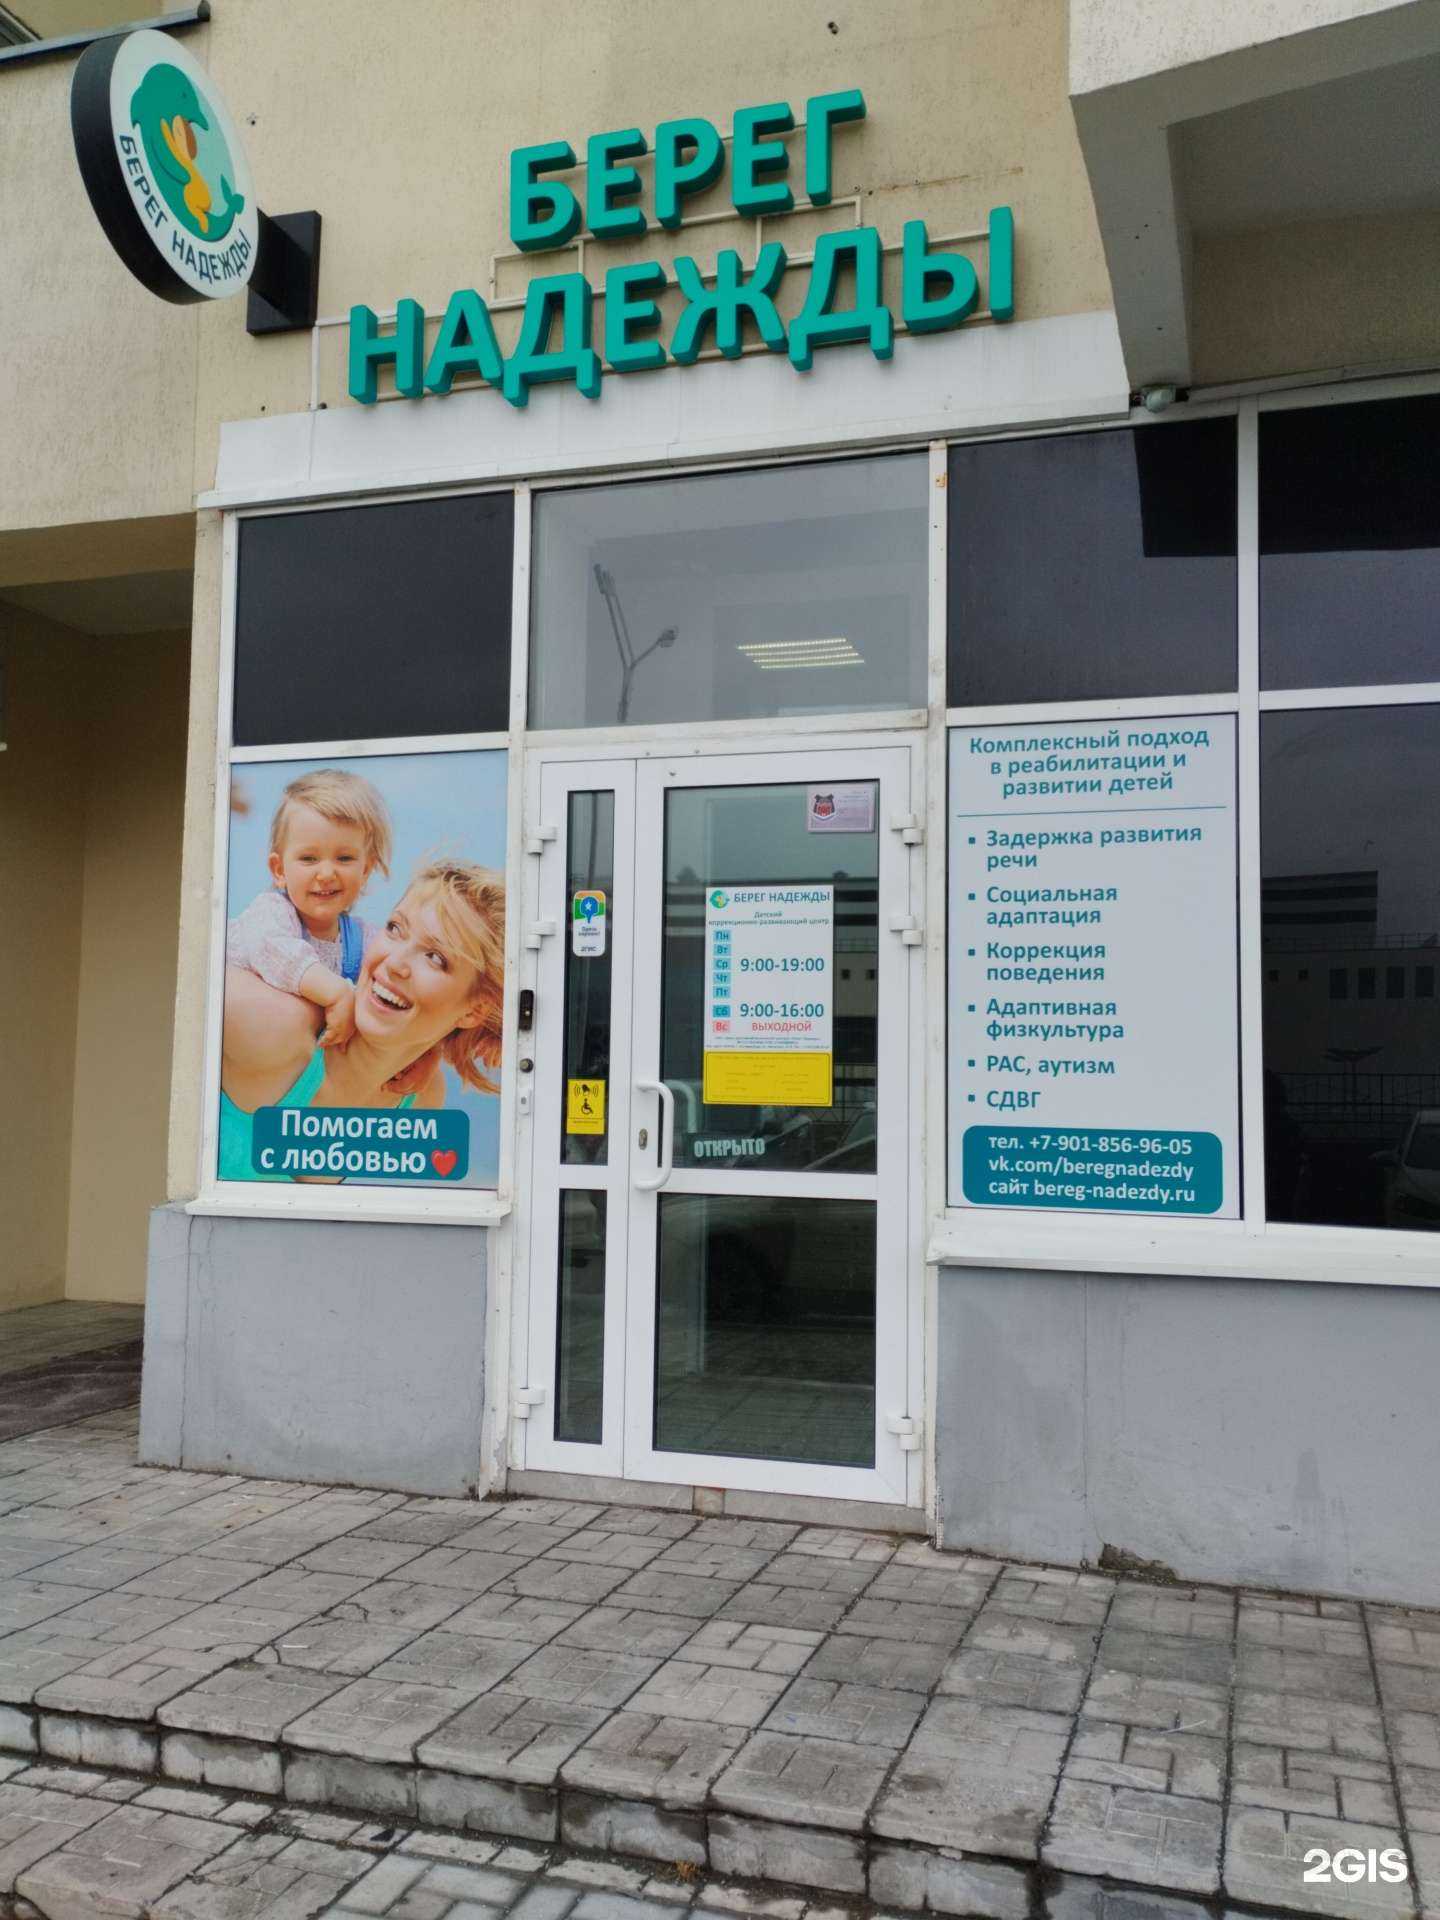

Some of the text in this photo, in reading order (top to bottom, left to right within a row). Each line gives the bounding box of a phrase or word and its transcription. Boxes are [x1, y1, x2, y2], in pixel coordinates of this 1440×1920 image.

[510, 89, 867, 253] БЕРЕГ
[119, 133, 251, 285] БЕРЕГ НАДЕЖДЫ
[348, 206, 1014, 407] НАДЕЖДЫ
[969, 730, 1210, 754] Комплексный подход
[990, 753, 1187, 778] в реабилитации и
[1002, 772, 1173, 800] развитии детей
[986, 826, 1202, 850] Задержка развития
[986, 853, 1038, 872] речи
[734, 890, 831, 904] БЕРЕГ НАДЕЖДЫ
[986, 885, 1118, 904] Социальная
[986, 908, 1102, 928] адаптация
[715, 931, 729, 940] Пн
[716, 945, 728, 953] Вт
[986, 941, 1106, 962] Коррекция
[716, 959, 728, 970] Ср
[740, 958, 825, 972] 9:00-19:00
[716, 974, 728, 982] Чт
[986, 966, 1105, 985] поведения
[716, 987, 728, 995] Пт
[739, 1003, 824, 1018] 9:00-16:00
[986, 998, 1117, 1018] Адаптивная
[715, 1021, 729, 1031] Вс
[751, 1020, 813, 1033] ВЫХОДНОЙ
[986, 1020, 1125, 1042] физкультура
[986, 1055, 1115, 1077] РАС, аутизм
[986, 1090, 1041, 1112] СДВГ
[280, 1109, 438, 1140] Помогаем
[693, 1137, 766, 1158] ОТКРЫТО
[988, 1135, 1193, 1155] тел. +7-901-856-96-05
[260, 1141, 426, 1174] с любовью
[988, 1155, 1195, 1182] vk.com/beregnadezdy
[988, 1179, 1196, 1204] сайт bereg-nadezdy.ru
